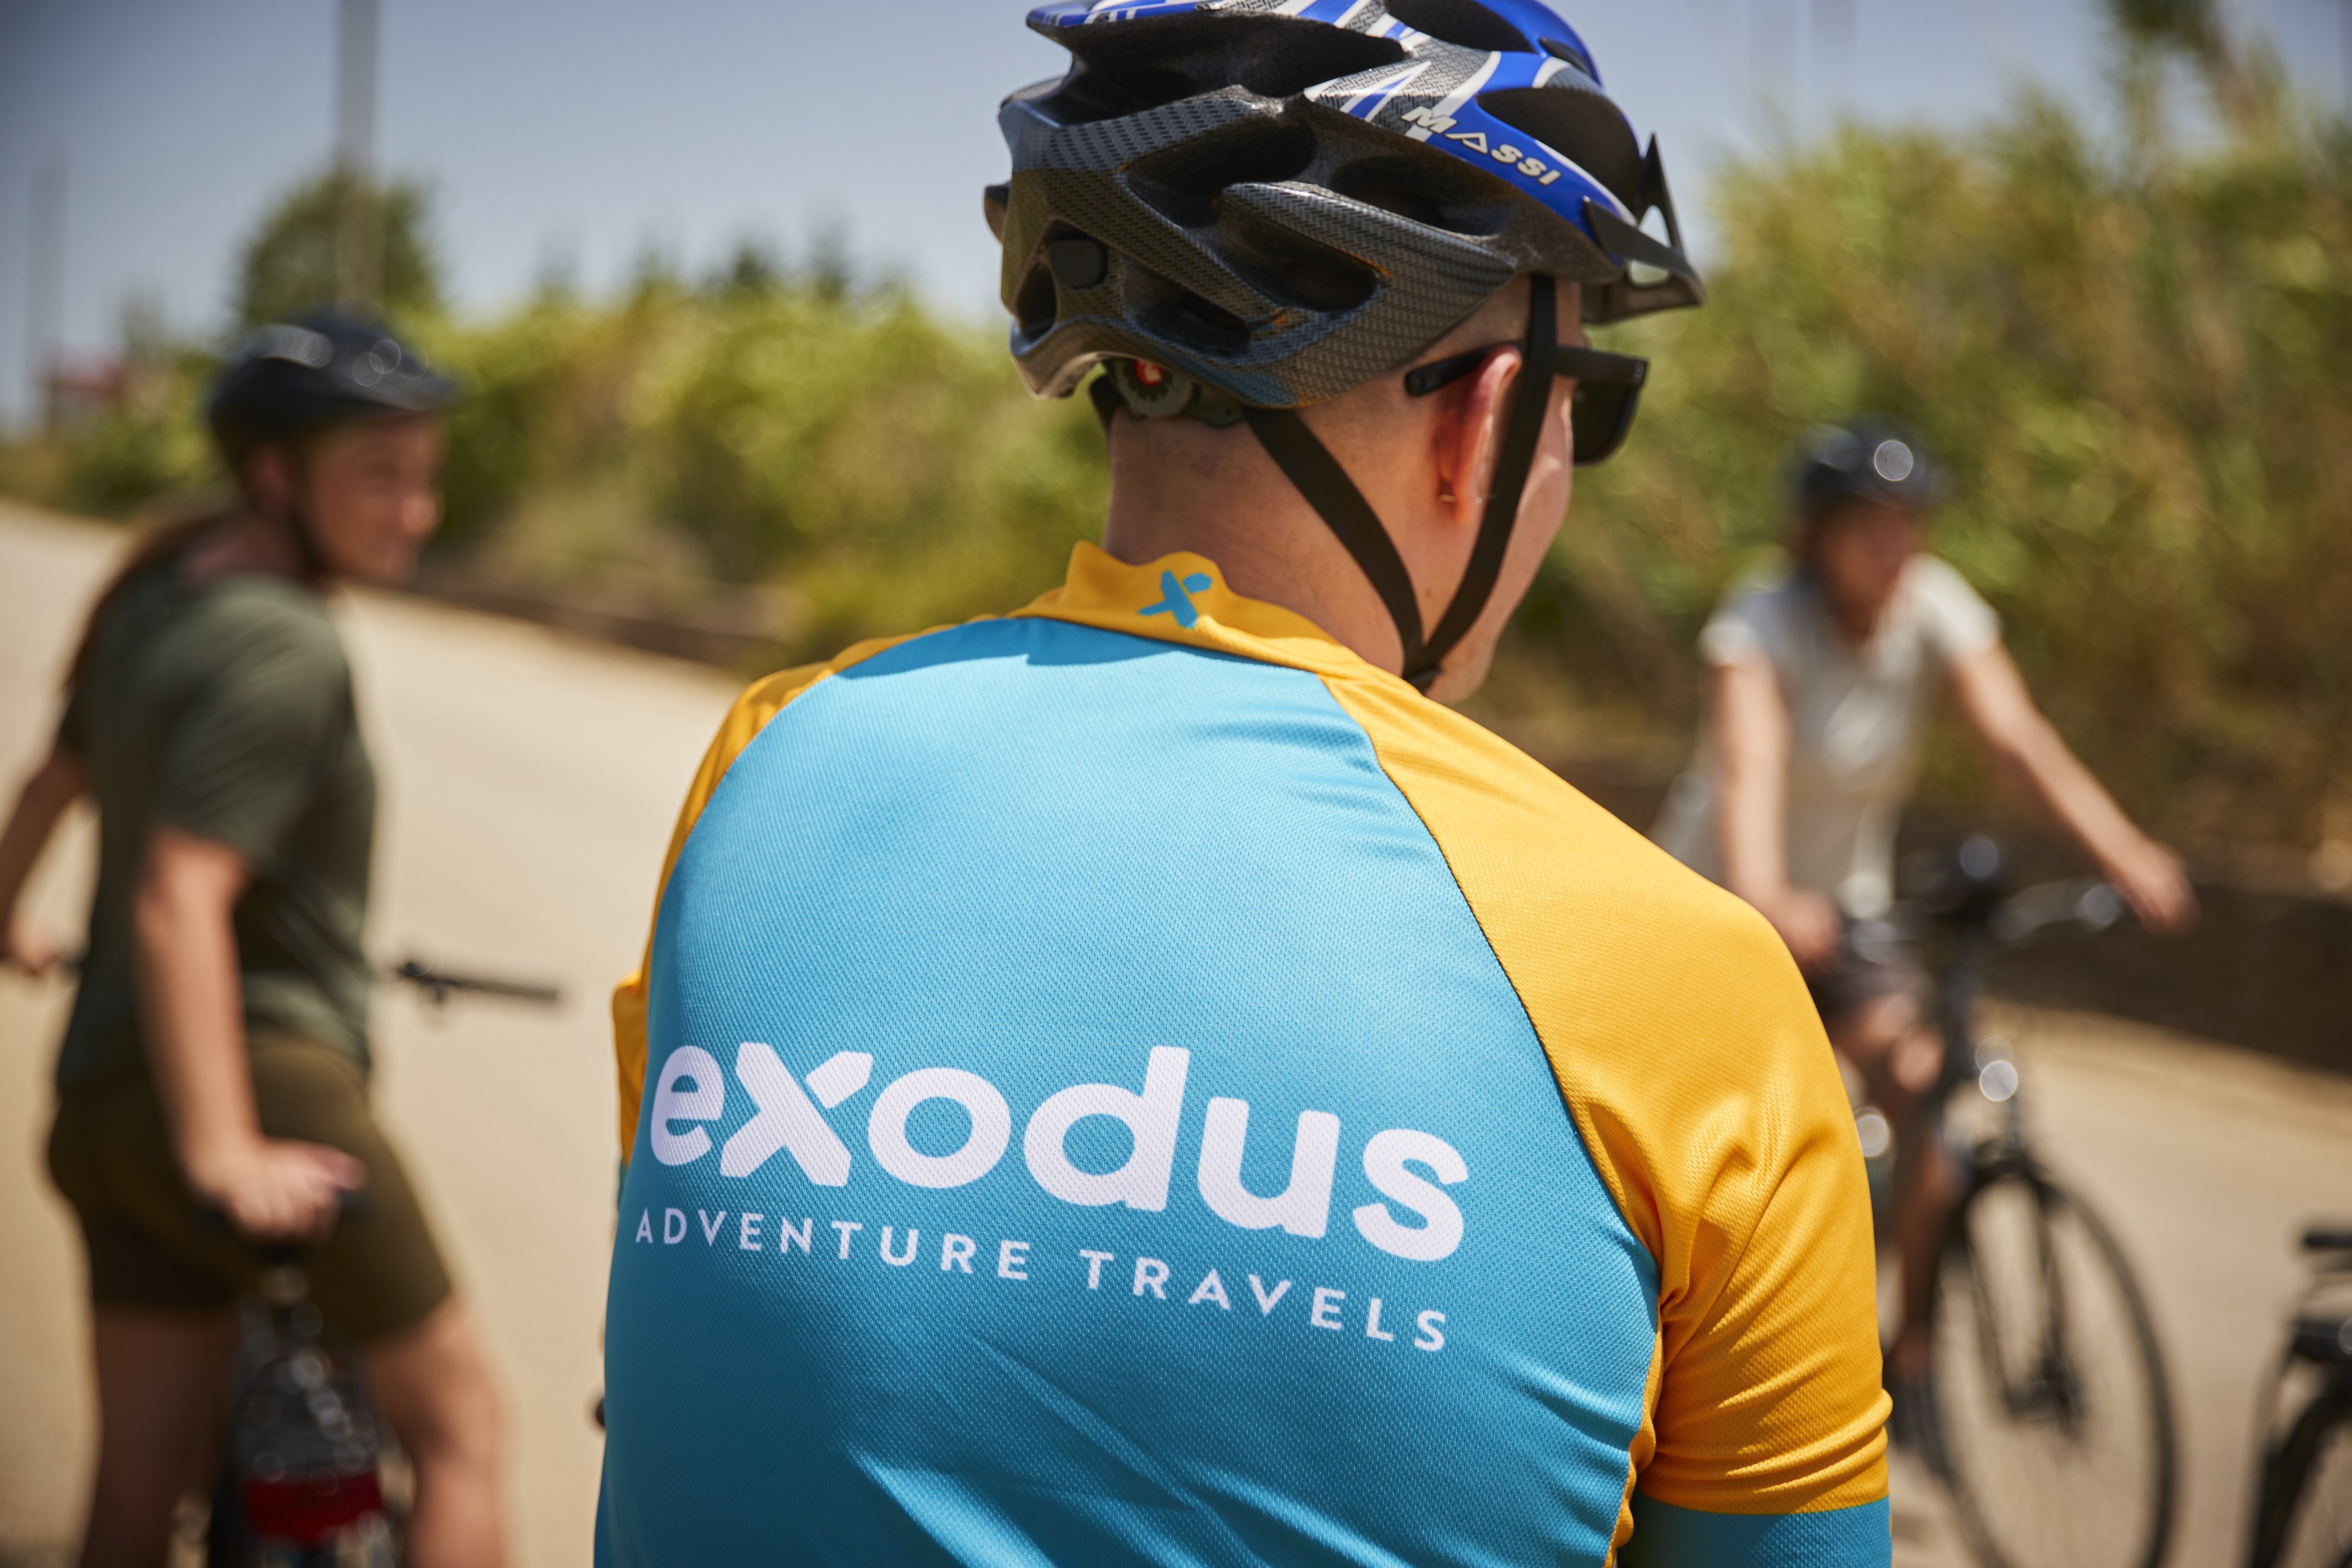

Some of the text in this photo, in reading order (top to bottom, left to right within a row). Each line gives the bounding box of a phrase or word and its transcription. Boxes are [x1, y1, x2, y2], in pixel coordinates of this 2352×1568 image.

[1401, 105, 1562, 186] MASSI
[650, 1042, 1468, 1261] exodus
[635, 1208, 1447, 1351] ADVENTURE TRAVELS
